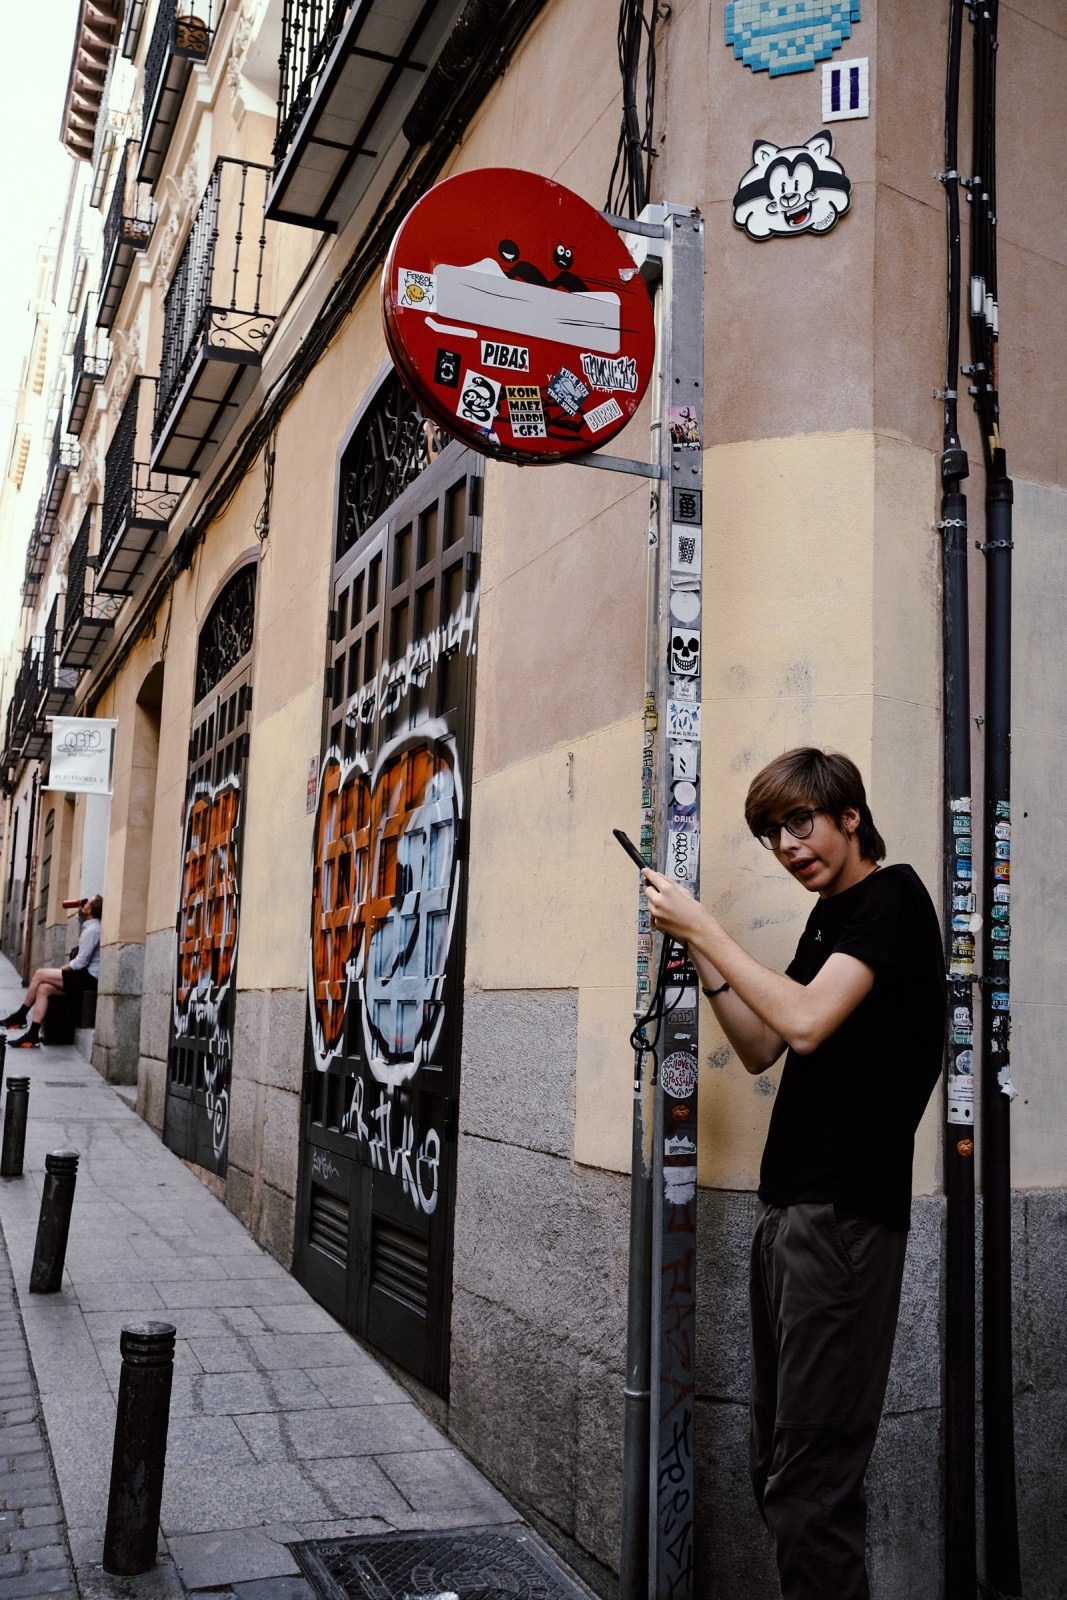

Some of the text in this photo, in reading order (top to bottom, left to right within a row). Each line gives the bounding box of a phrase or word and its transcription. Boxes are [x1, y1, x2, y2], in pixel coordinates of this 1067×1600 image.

[483, 343, 528, 369] PIBAS
[560, 367, 578, 384] FUCK
[577, 382, 590, 398] ISIS
[507, 387, 539, 398] KOIN
[547, 388, 561, 402] THAT
[511, 413, 544, 422] HARDI
[586, 400, 622, 430] BURRO
[518, 424, 540, 437] GFS
[673, 1059, 690, 1071] LOVE
